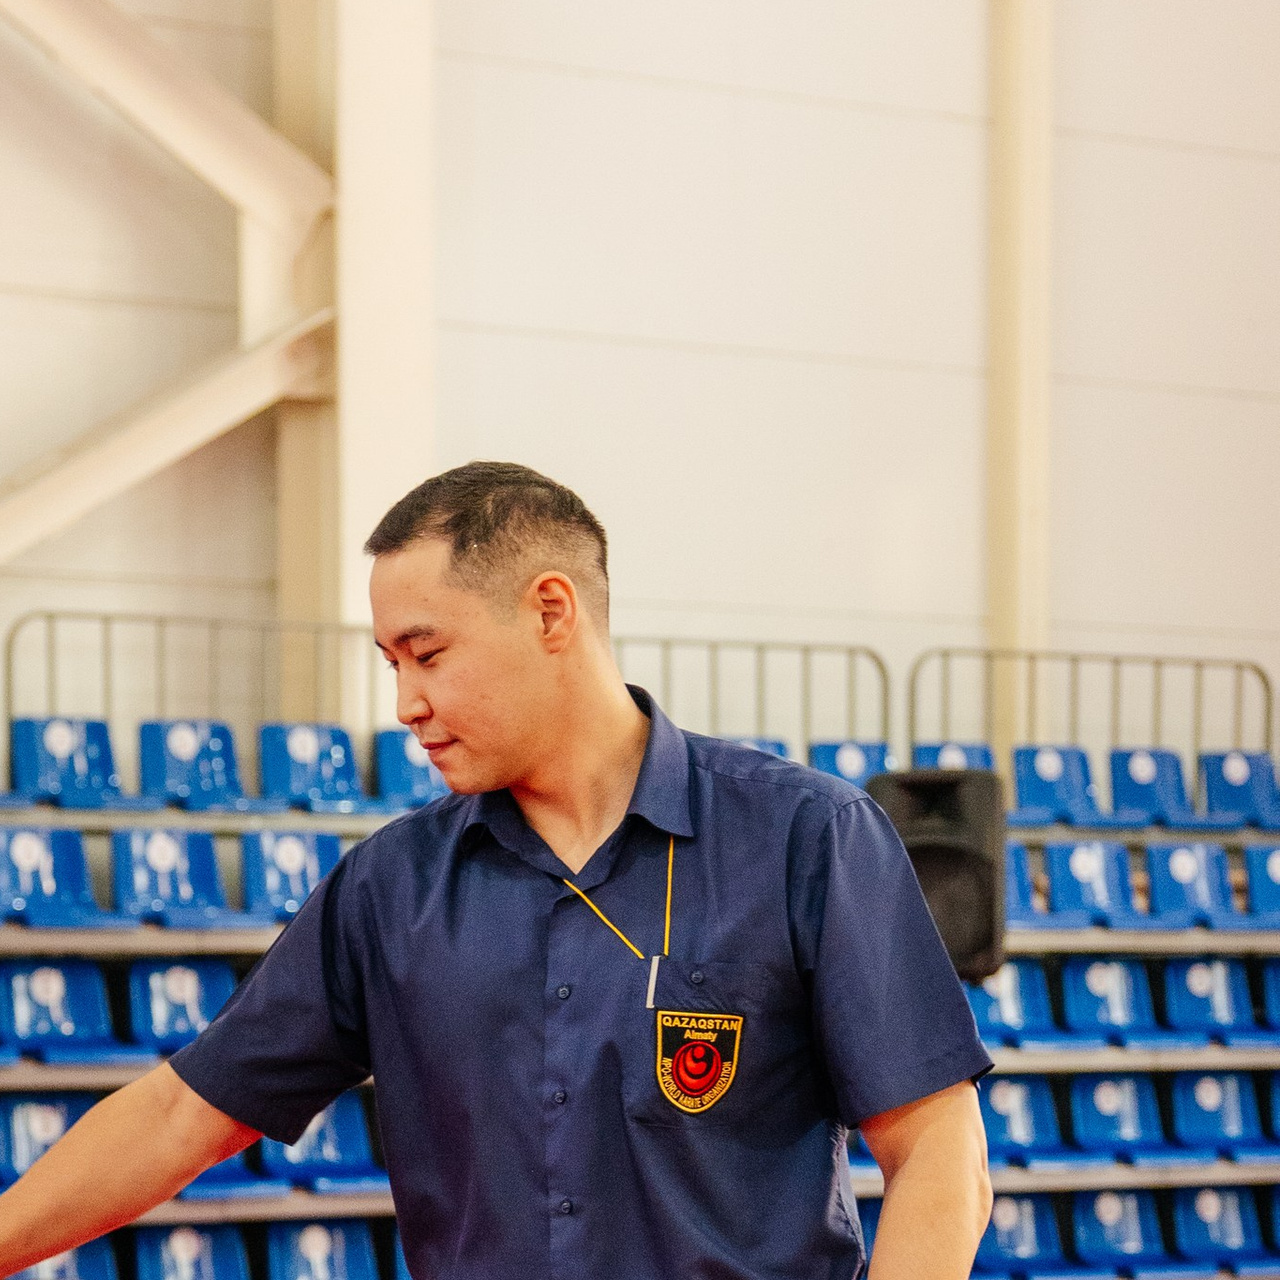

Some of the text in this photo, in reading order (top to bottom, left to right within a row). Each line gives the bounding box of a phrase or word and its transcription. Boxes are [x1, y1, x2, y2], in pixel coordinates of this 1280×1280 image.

[662, 1016, 739, 1031] QAZAQSTAN
[683, 1029, 718, 1042] Almaty
[701, 1061, 732, 1105] ORGANIZATION
